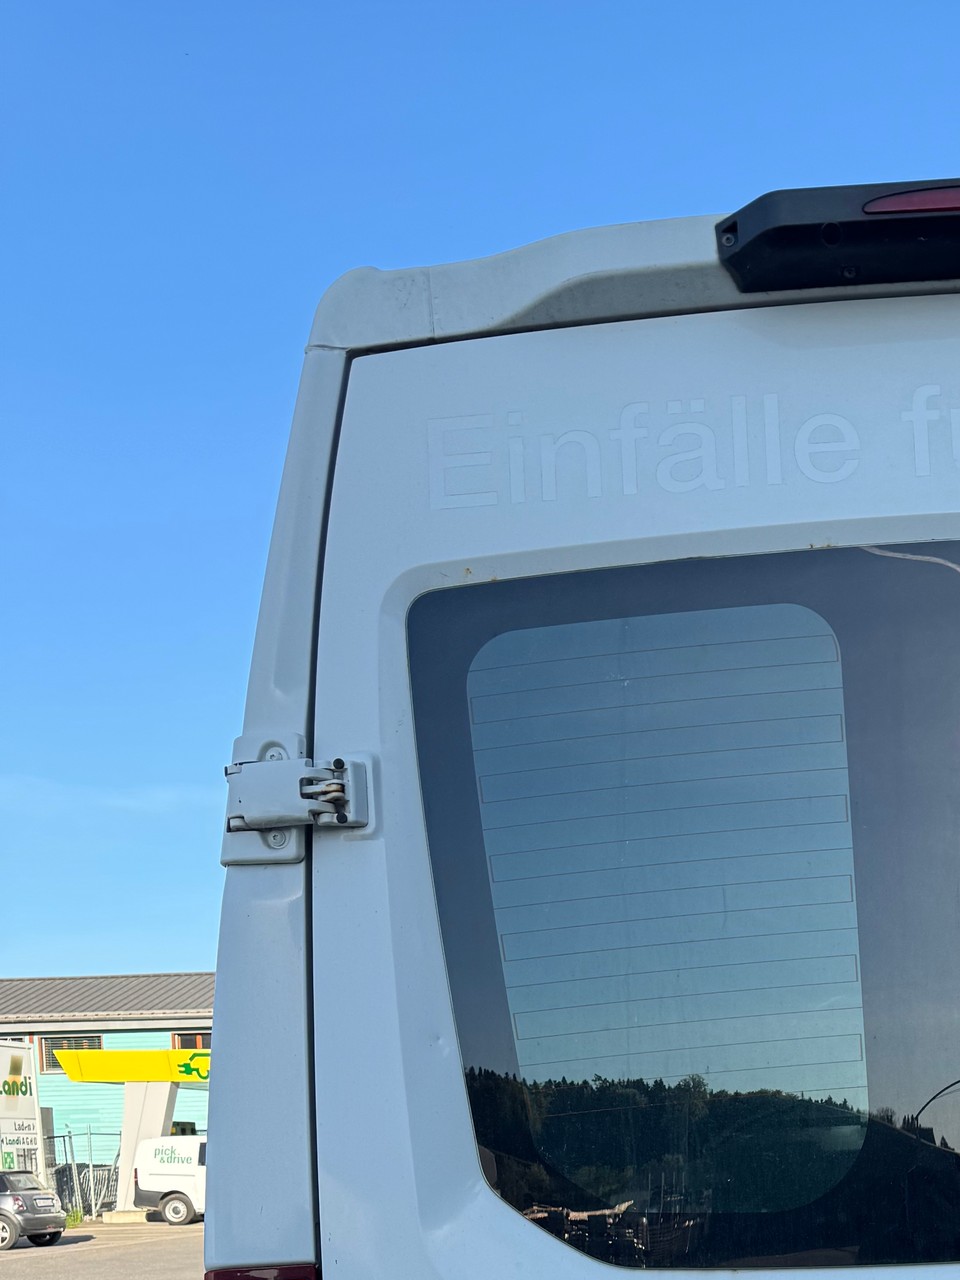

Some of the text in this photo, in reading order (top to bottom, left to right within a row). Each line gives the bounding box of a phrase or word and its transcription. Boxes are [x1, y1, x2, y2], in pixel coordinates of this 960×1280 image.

[425, 393, 862, 512] Einfälle
[0, 1076, 33, 1097] andi
[154, 1145, 177, 1159] pick
